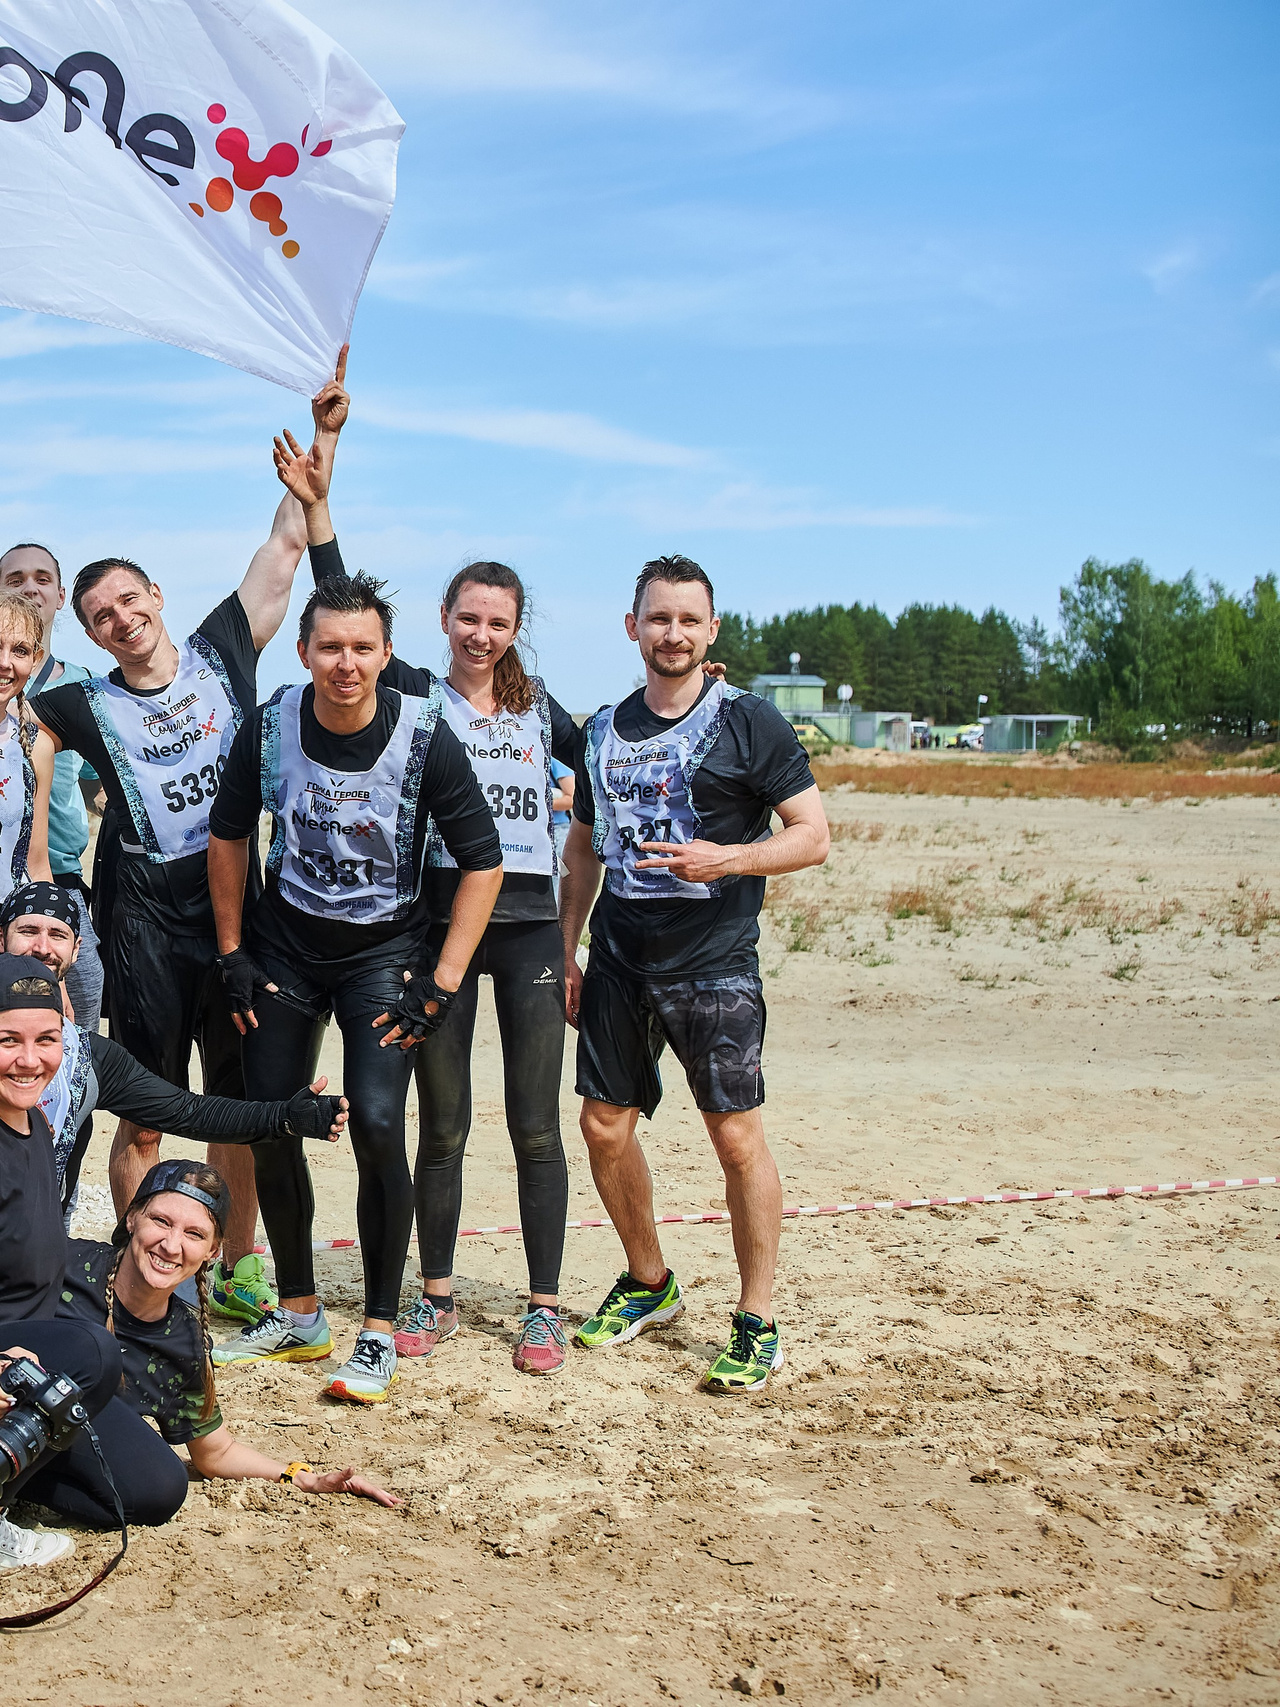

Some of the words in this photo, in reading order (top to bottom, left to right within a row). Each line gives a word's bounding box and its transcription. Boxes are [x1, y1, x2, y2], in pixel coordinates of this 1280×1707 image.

[143, 711, 170, 724] ГОНКА
[170, 692, 198, 714] ГЕРОЕВ
[142, 708, 222, 763] Neoflex
[606, 757, 631, 767] ГОНКА
[633, 750, 669, 763] ГЕРОЕВ
[306, 781, 332, 798] ГОНКА
[333, 790, 371, 799] ГЕРОЕВ
[478, 783, 539, 822] 336
[607, 772, 676, 803] eoflex
[292, 809, 379, 842] Neoflex
[500, 843, 534, 853] РОМБАНК
